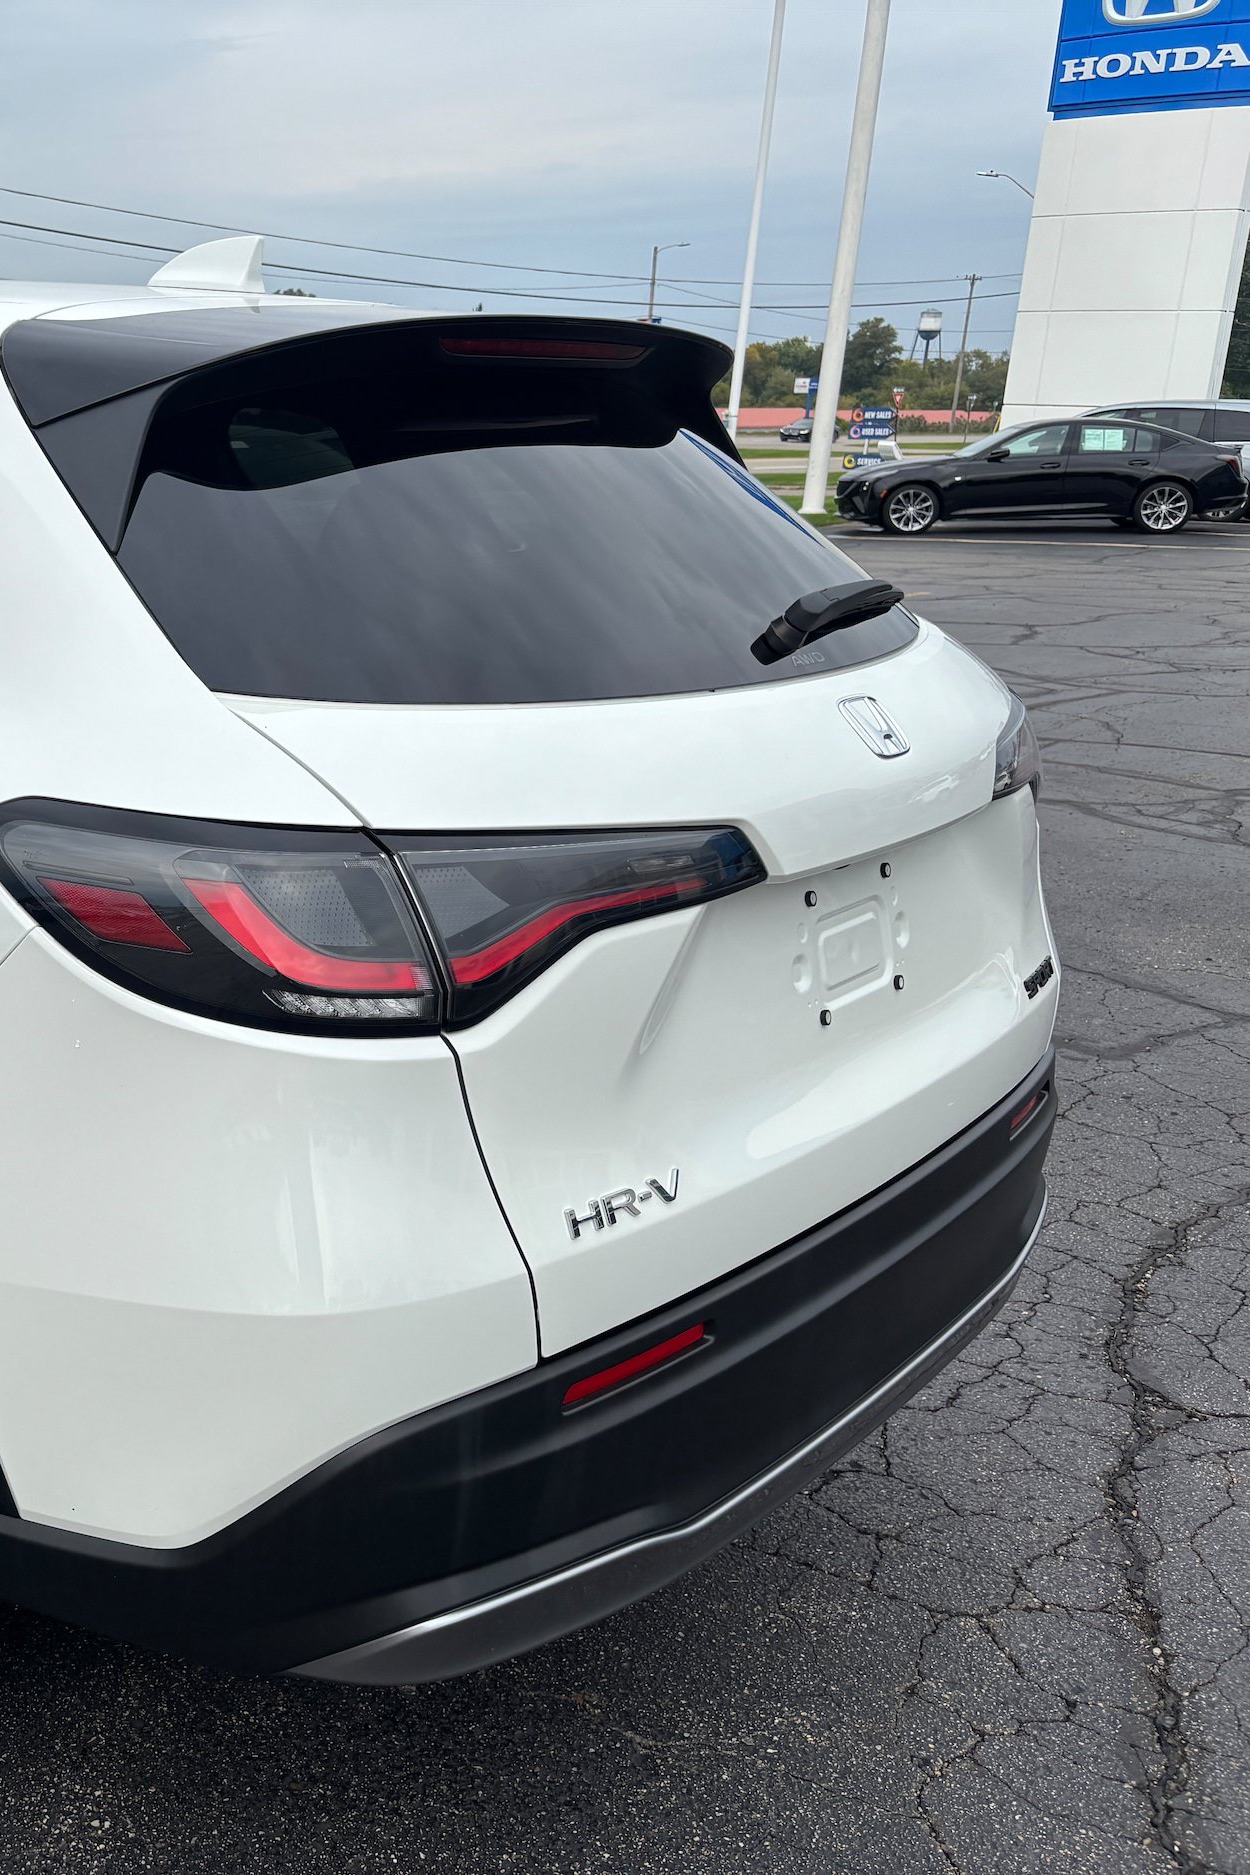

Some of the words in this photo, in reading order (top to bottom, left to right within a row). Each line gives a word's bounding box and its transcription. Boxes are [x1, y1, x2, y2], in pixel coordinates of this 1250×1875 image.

[1059, 43, 1250, 83] HONDA
[865, 411, 876, 419] NEW
[876, 411, 892, 419] SALES
[862, 428, 875, 436] USED
[875, 428, 889, 436] SALES
[791, 652, 825, 667] AWD
[563, 1167, 680, 1241] HR-V
